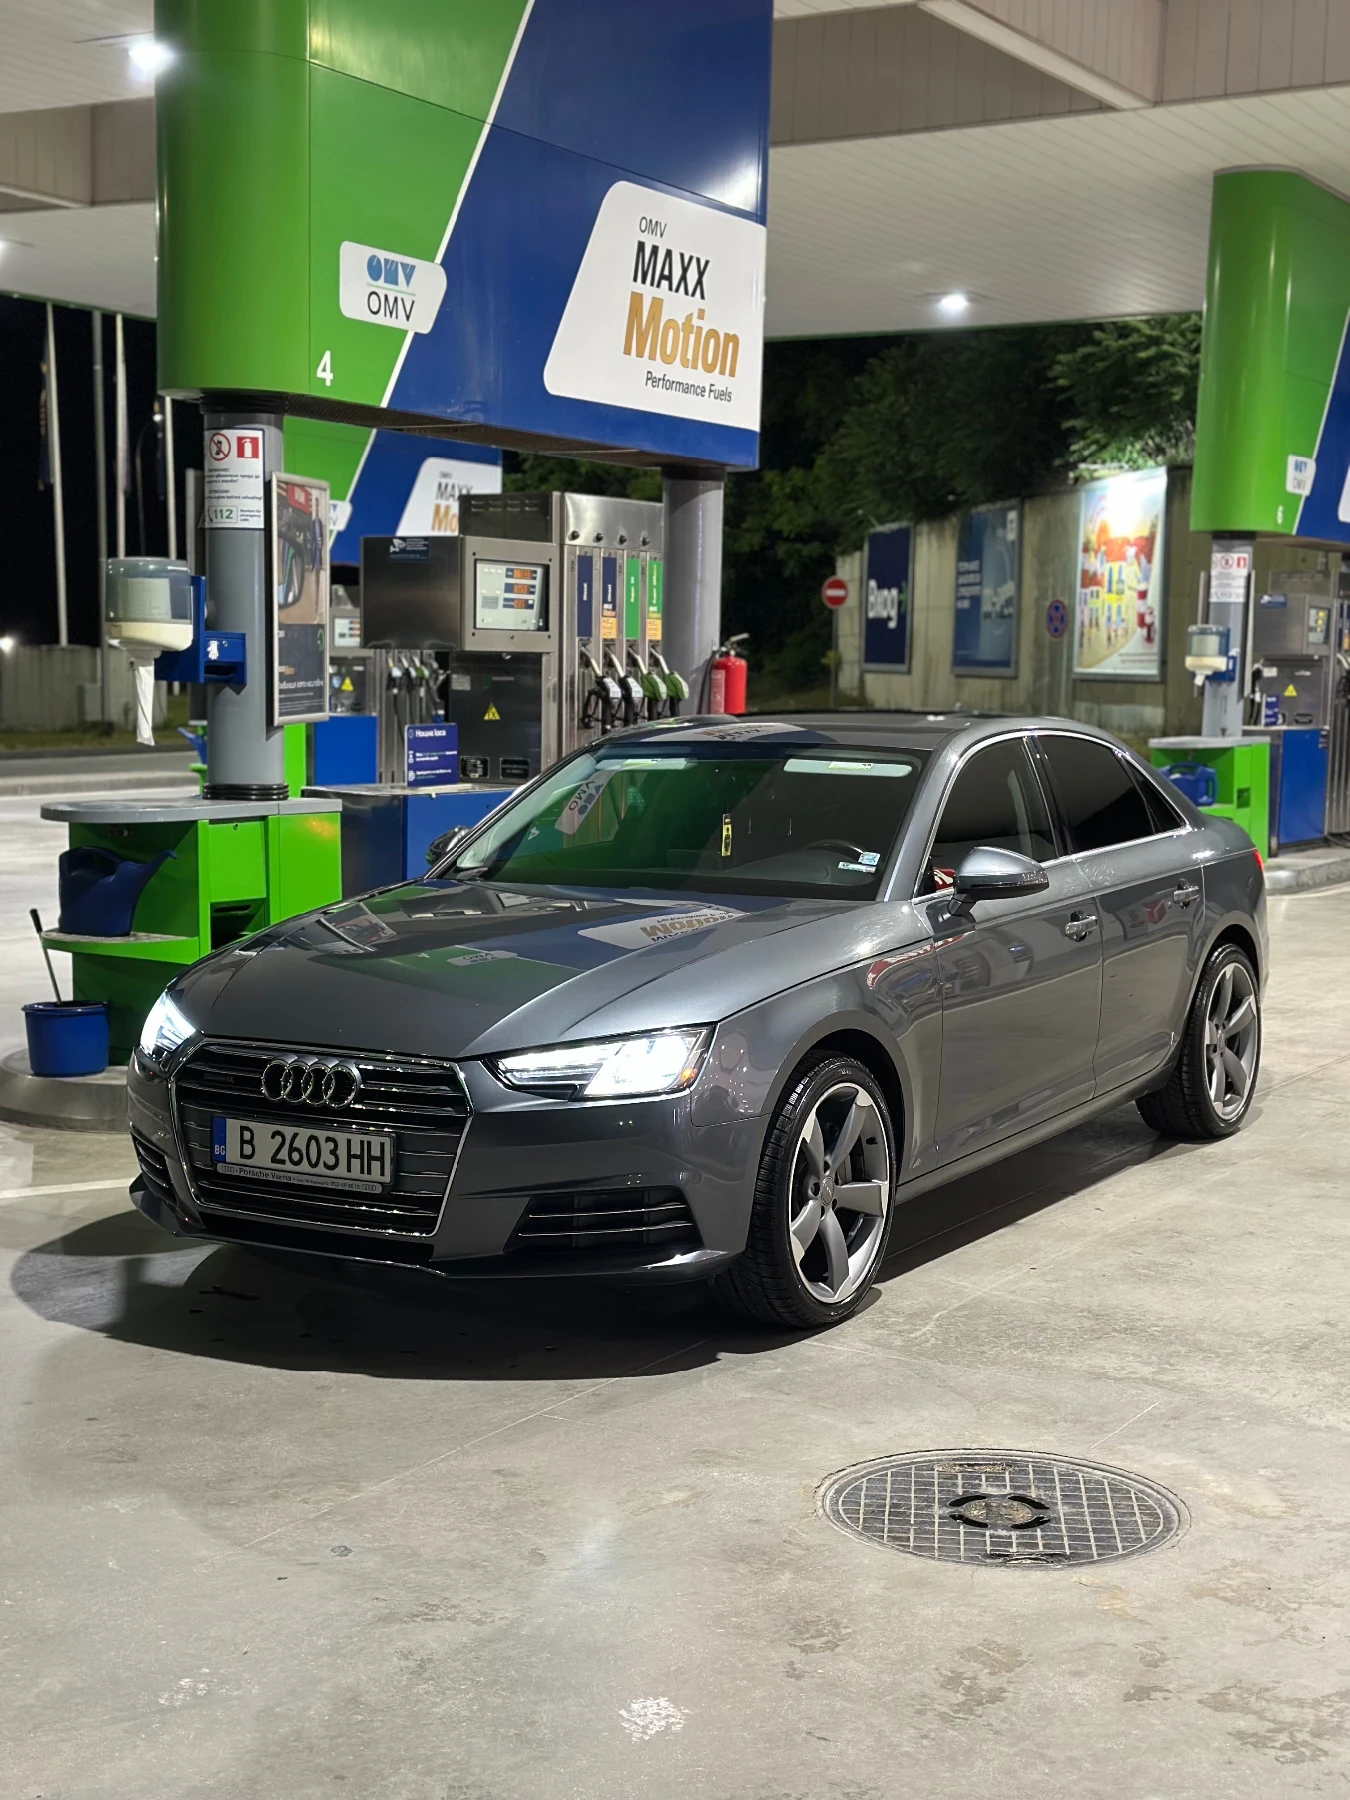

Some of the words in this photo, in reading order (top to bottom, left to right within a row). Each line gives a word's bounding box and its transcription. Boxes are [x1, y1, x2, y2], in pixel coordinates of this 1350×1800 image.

[638, 216, 667, 239] OMV
[632, 240, 710, 301] MAXX
[366, 290, 416, 323] OMV
[622, 291, 740, 379] Motion
[316, 350, 334, 387] 4
[645, 371, 706, 399] Performance
[708, 387, 733, 403] Fuels
[213, 508, 234, 520] 112
[1276, 505, 1284, 525] 6
[214, 1144, 226, 1156] BG
[239, 1125, 256, 1160] B
[270, 1129, 340, 1172] 2603
[346, 1137, 385, 1177] HH
[238, 1167, 270, 1180] Porsche
[270, 1172, 292, 1182] Varna
